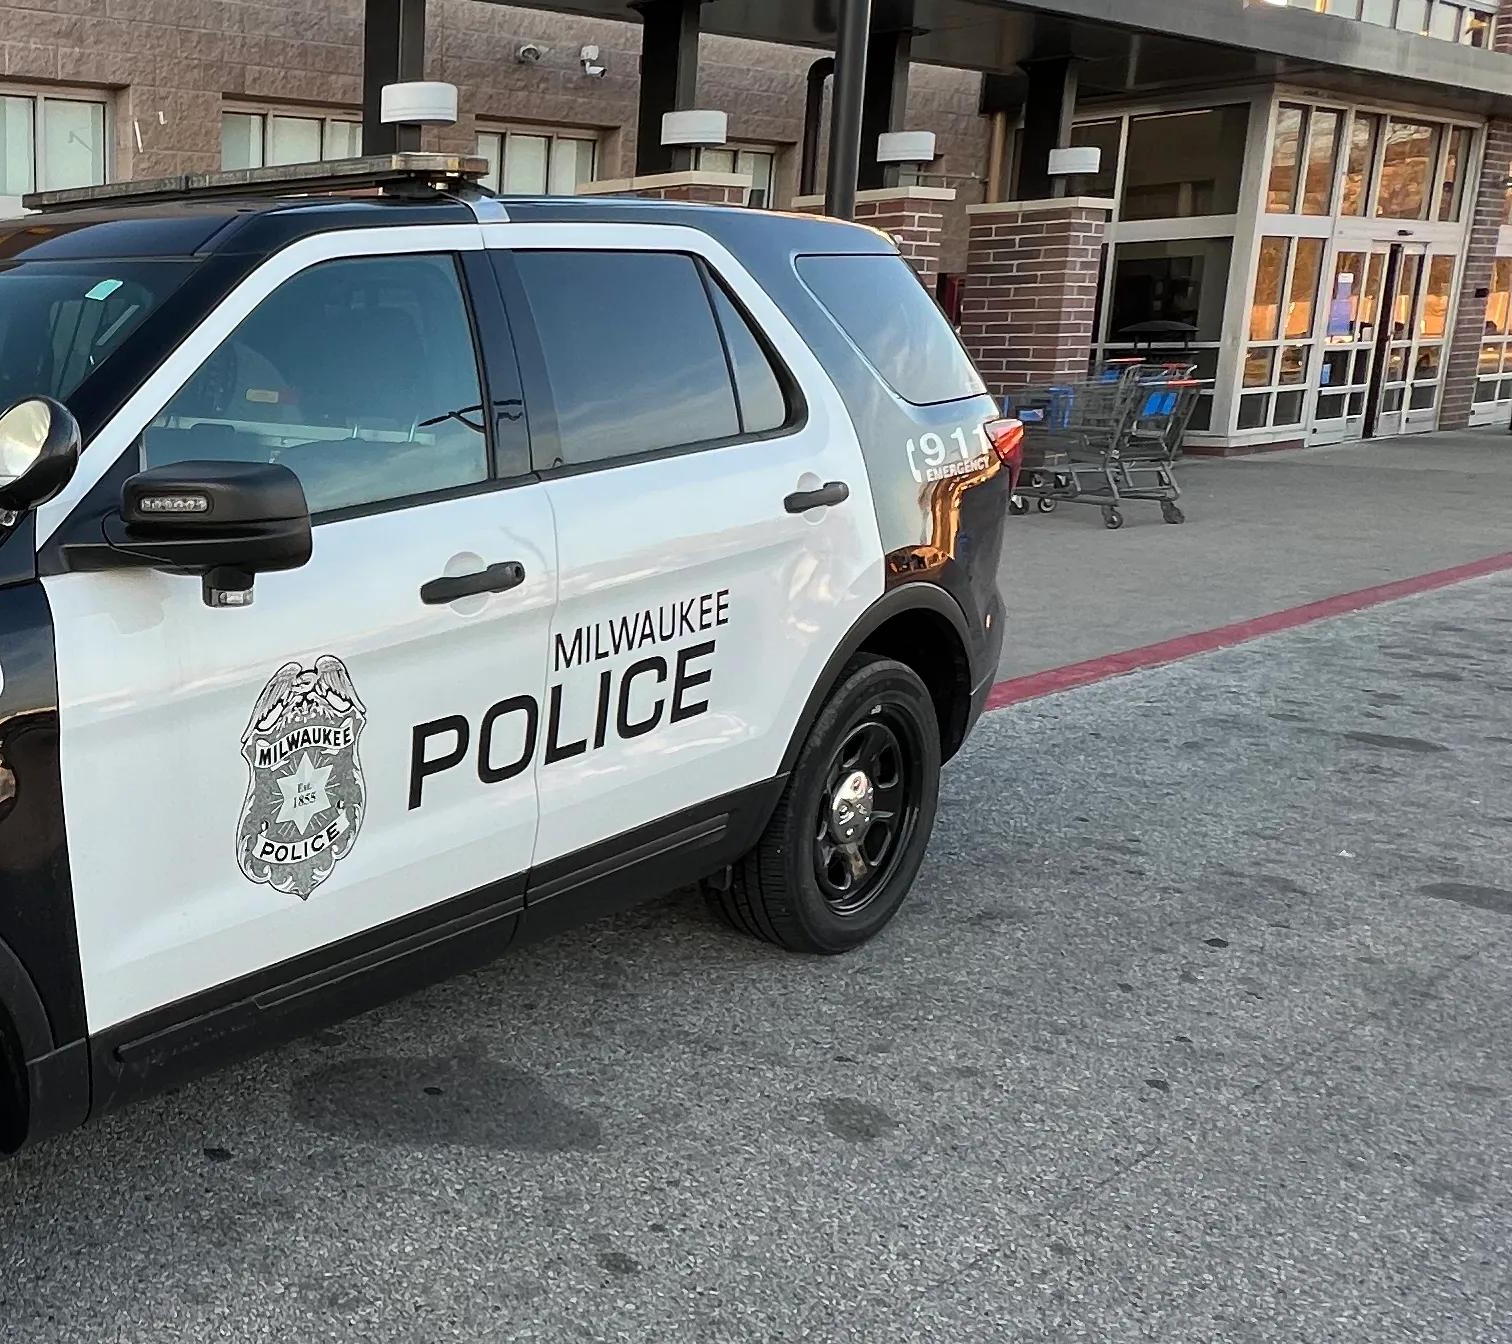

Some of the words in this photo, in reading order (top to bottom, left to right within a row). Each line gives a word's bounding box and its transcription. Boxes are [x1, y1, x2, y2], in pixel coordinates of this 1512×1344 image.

[919, 423, 990, 466] 911
[926, 456, 990, 482] EMERGENCY
[554, 589, 730, 672] MILWAUKEE
[407, 640, 716, 811] POLICE
[258, 726, 352, 766] MILWAUKEE
[293, 792, 317, 809] 1855
[260, 822, 339, 861] POLICE
